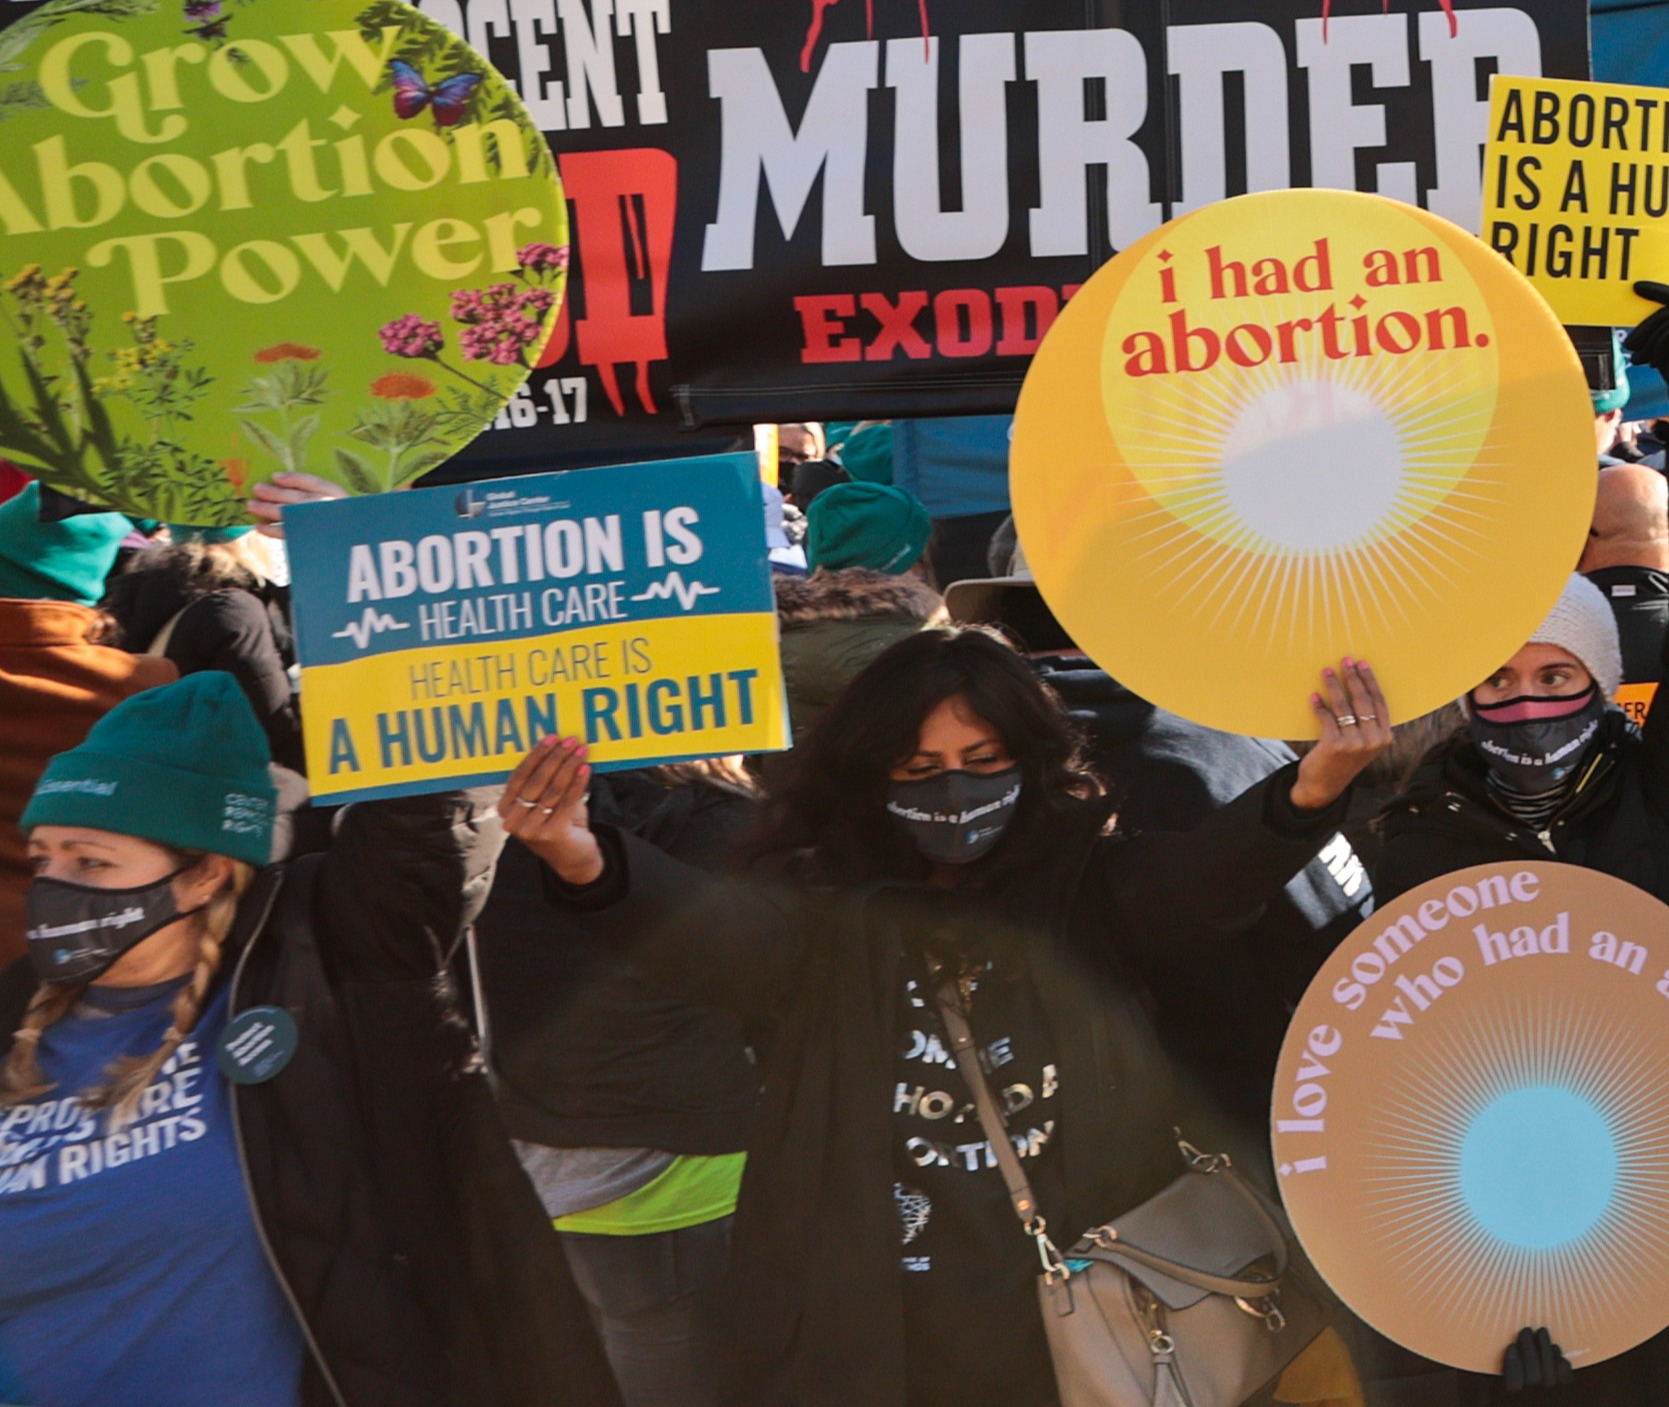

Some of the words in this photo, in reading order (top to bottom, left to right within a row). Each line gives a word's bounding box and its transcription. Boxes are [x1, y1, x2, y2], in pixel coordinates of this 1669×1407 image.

[39, 24, 402, 143] Grow
[1494, 155, 1541, 213] IS
[1558, 161, 1591, 214] A
[85, 206, 542, 319] Power
[1160, 249, 1180, 304] i
[1205, 237, 1332, 303] had
[1364, 245, 1444, 287] an
[1490, 221, 1640, 282] RIGHT
[1120, 294, 1490, 377] abortion.
[347, 513, 624, 603] ABORTION
[642, 506, 703, 569] IS
[419, 593, 534, 642] HEALTH
[542, 580, 628, 626] CARE
[409, 653, 517, 701] HEALTH
[527, 644, 609, 688] CARE
[622, 637, 653, 674] IS
[328, 718, 360, 776] A
[377, 693, 559, 769] HUMAN
[582, 669, 758, 745] RIGHT
[1332, 870, 1541, 1011] someone
[1370, 955, 1466, 1044] who
[1473, 912, 1571, 966] had
[1589, 930, 1649, 976] an
[1275, 1023, 1344, 1136] love
[59, 1105, 208, 1186] RIGHTS
[1278, 1155, 1328, 1177] i
